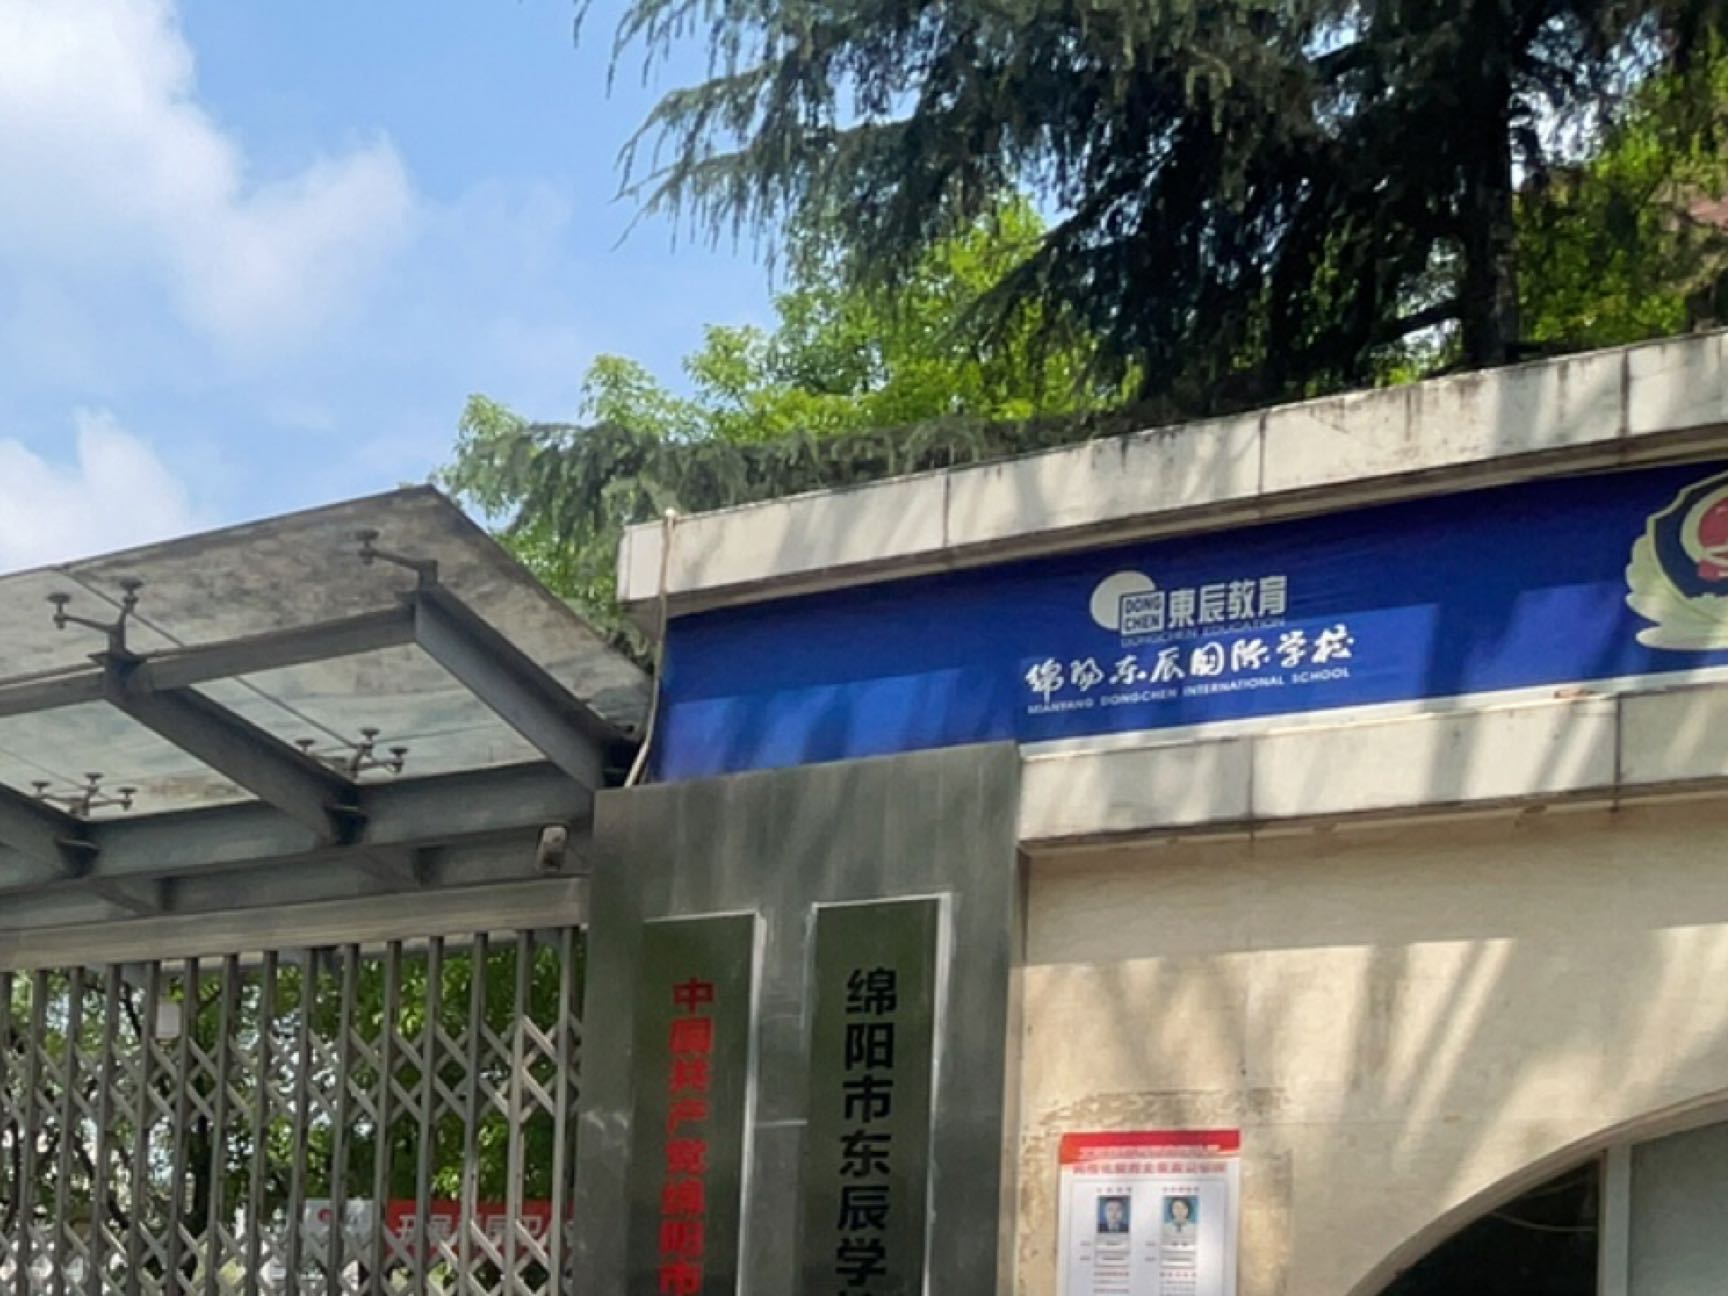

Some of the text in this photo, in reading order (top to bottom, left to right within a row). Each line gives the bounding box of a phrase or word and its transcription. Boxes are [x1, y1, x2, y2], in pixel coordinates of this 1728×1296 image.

[1125, 597, 1161, 614] DONG
[1167, 575, 1288, 629] 東辰教育
[1125, 613, 1160, 632] CHEN
[1183, 676, 1285, 697] INTERNATIONAL
[1292, 667, 1350, 684] SCHOOL
